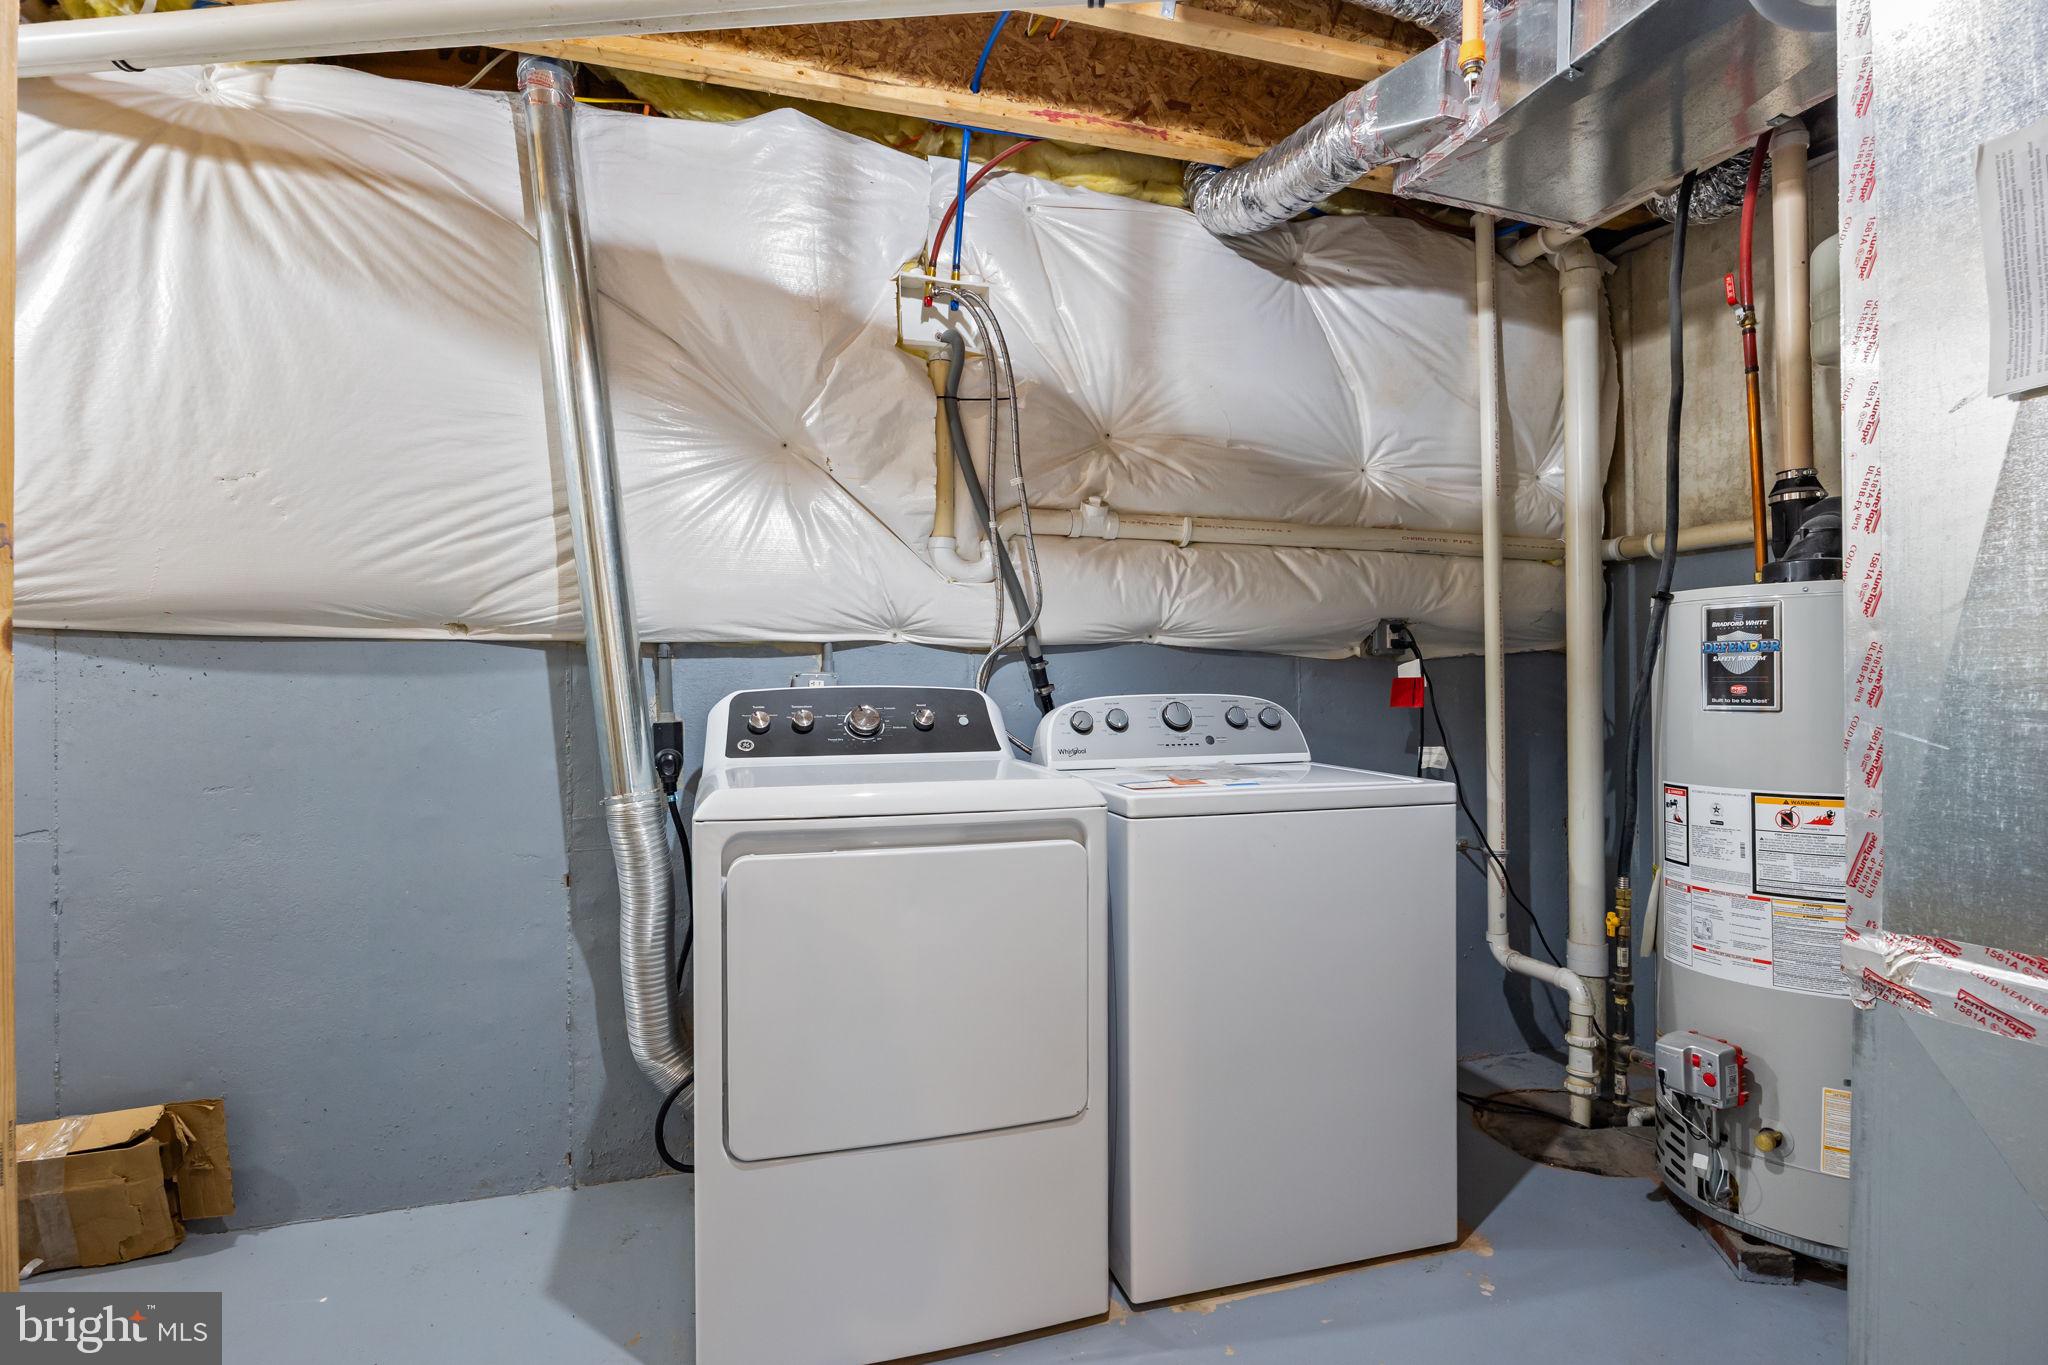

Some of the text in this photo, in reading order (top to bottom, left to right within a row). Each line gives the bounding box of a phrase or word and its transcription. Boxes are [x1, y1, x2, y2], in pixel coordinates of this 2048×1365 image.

[1860, 216, 1876, 245] 1581A
[1862, 380, 1879, 409] 1581A
[1863, 487, 1881, 535] ureTape
[1401, 535, 1448, 543] CHARLOTTE
[1844, 545, 1857, 569] COLD
[1864, 552, 1881, 580] 1581A
[1712, 619, 1744, 628] BRADFORD
[1703, 639, 1781, 653] DEFENDER
[1866, 666, 1883, 708] ureTape
[1847, 715, 1860, 738] COLD
[1866, 725, 1883, 752] 1581A
[1058, 747, 1087, 757] Whirlpool
[1849, 832, 1878, 889] VentureTape
[1857, 857, 1876, 895] UL181A-P
[1984, 947, 2019, 970] 1581A
[1970, 969, 2048, 1016] COLD WEATHER
[1953, 1001, 1987, 1026] 1581A
[1957, 989, 2036, 1040] VentureTape
